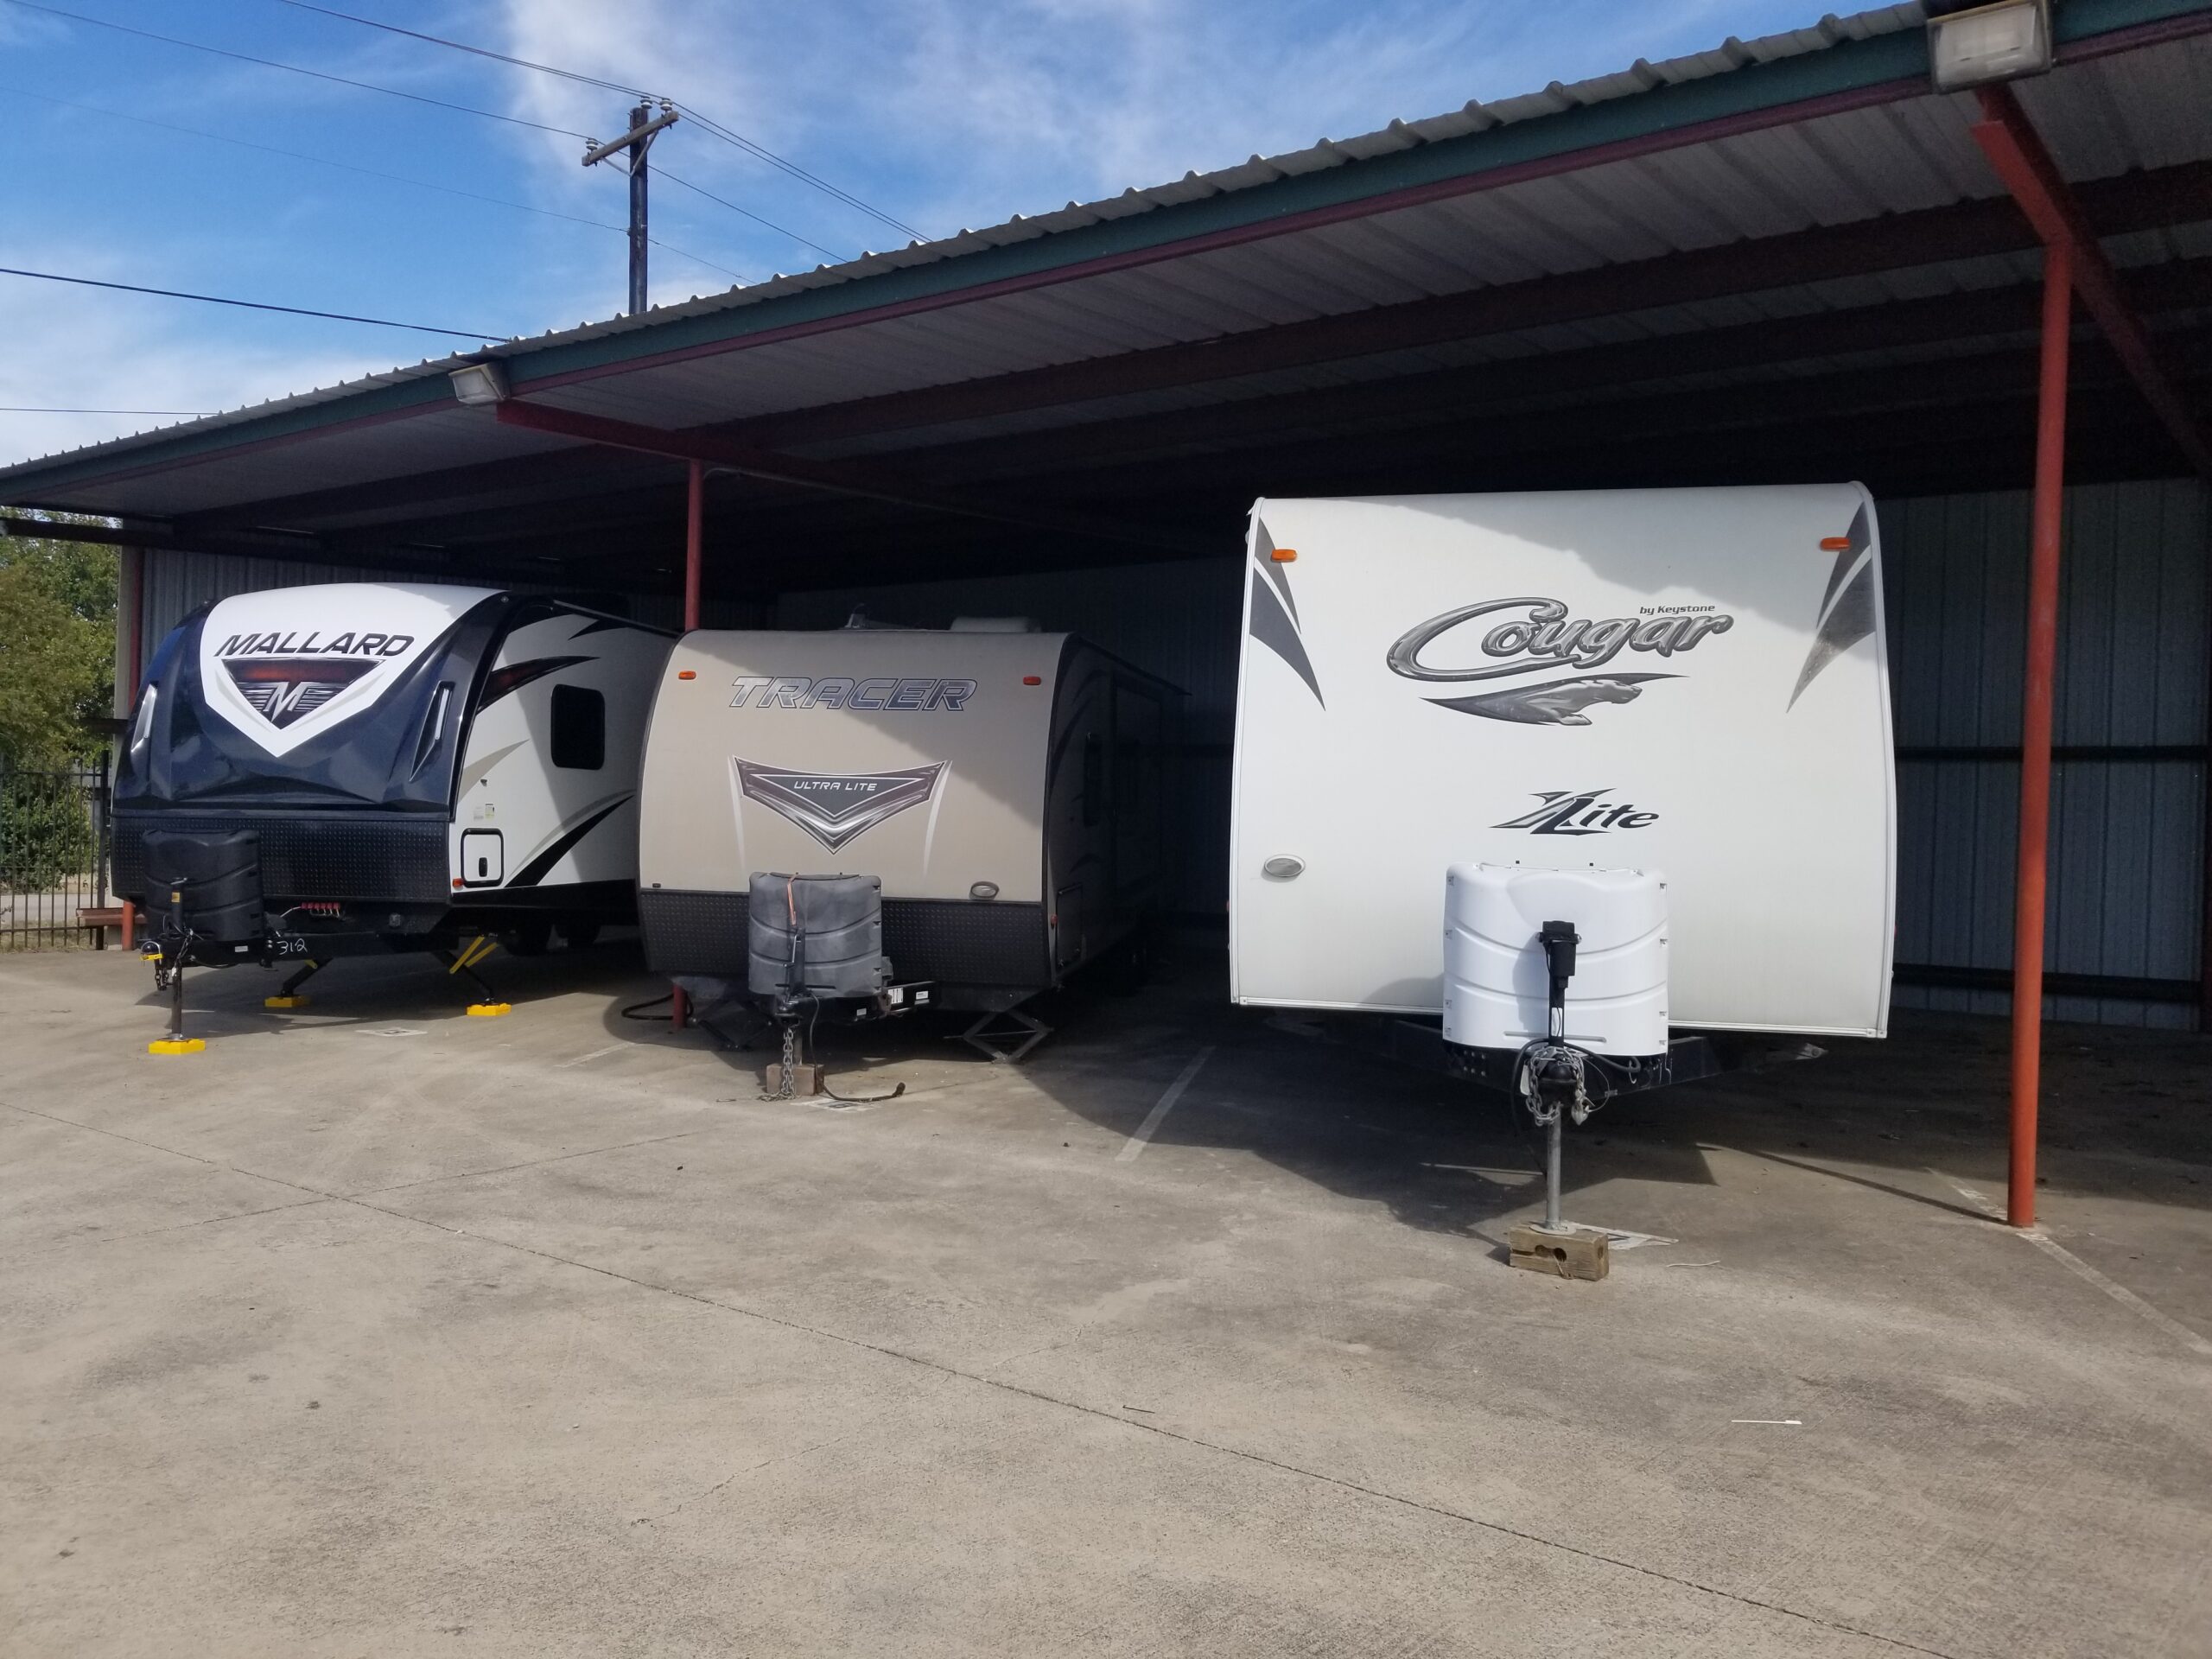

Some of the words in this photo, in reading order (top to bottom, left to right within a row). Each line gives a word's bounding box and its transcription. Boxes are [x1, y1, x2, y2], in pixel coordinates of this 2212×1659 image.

[1640, 607, 1655, 615] by
[1657, 606, 1715, 614] Keystone
[213, 632, 415, 657] MALLARD
[1387, 597, 1734, 682] Cougar
[729, 677, 977, 711] TRACER
[794, 781, 841, 791] ULTRA
[276, 938, 308, 955] 312
